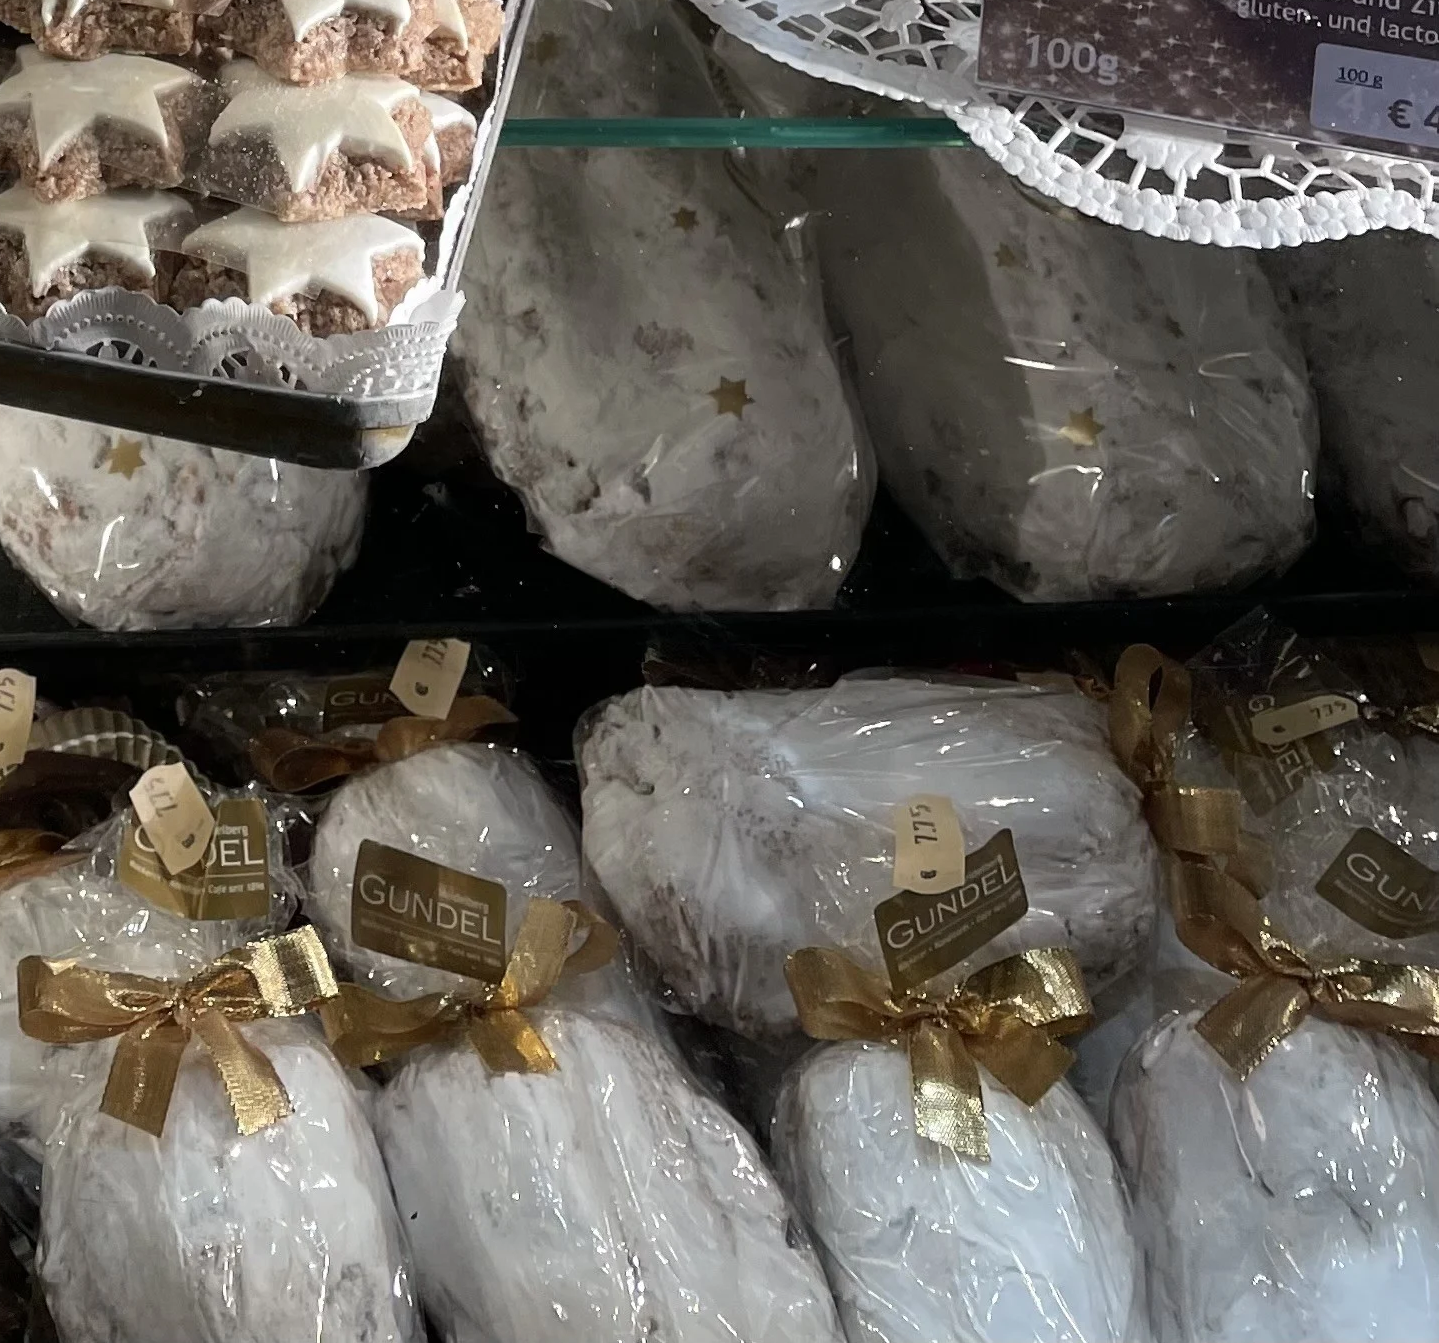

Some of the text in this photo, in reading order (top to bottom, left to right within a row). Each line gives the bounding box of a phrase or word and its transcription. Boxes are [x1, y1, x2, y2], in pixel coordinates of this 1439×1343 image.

[1328, 12, 1372, 35] und
[1025, 33, 1119, 87] 100g
[1337, 66, 1369, 85] 100
[1387, 98, 1413, 129] €
[359, 874, 503, 945] GUNDEL
[886, 854, 1018, 949] GUNDEL
